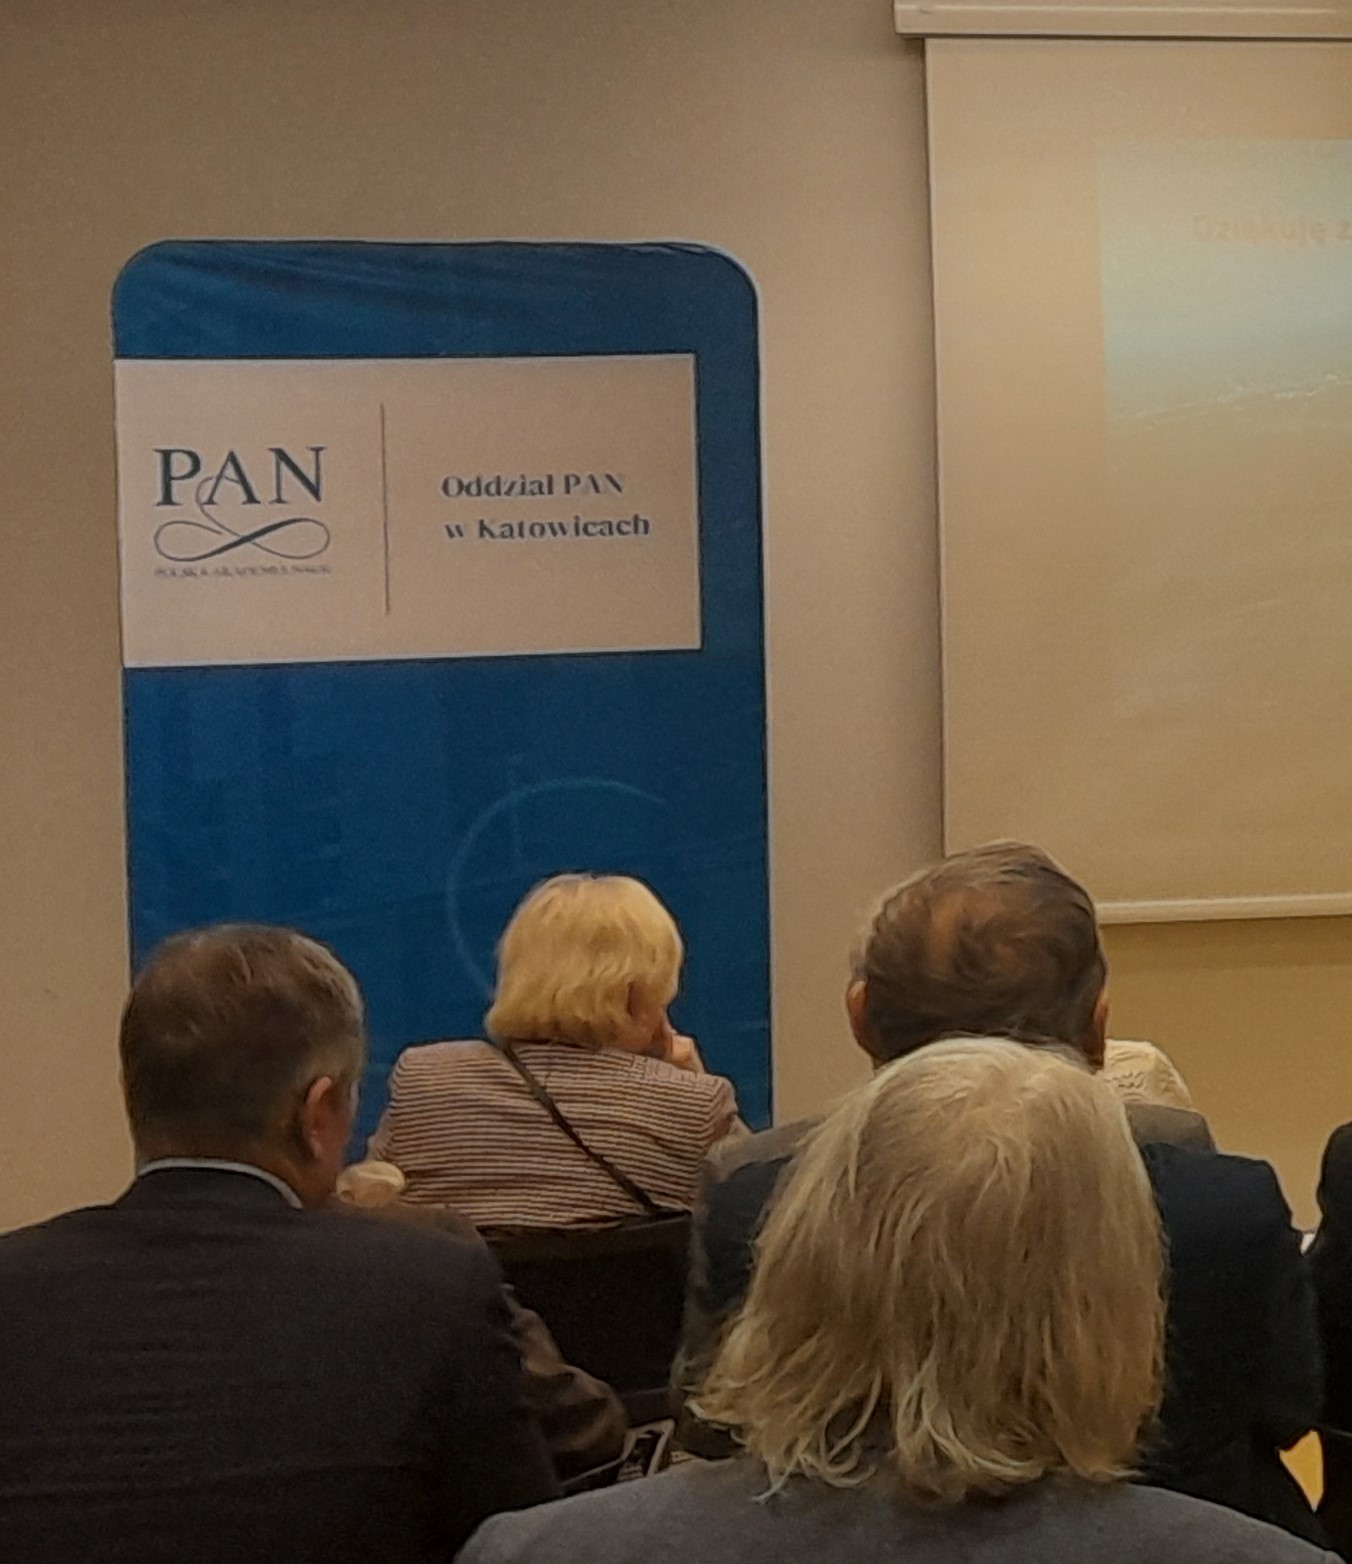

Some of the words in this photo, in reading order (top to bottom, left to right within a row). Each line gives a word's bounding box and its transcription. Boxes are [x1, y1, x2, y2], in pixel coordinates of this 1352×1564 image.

[153, 445, 328, 507] PAN
[563, 473, 624, 496] PAN
[444, 522, 465, 539] w
[477, 513, 650, 540] Katowicach
